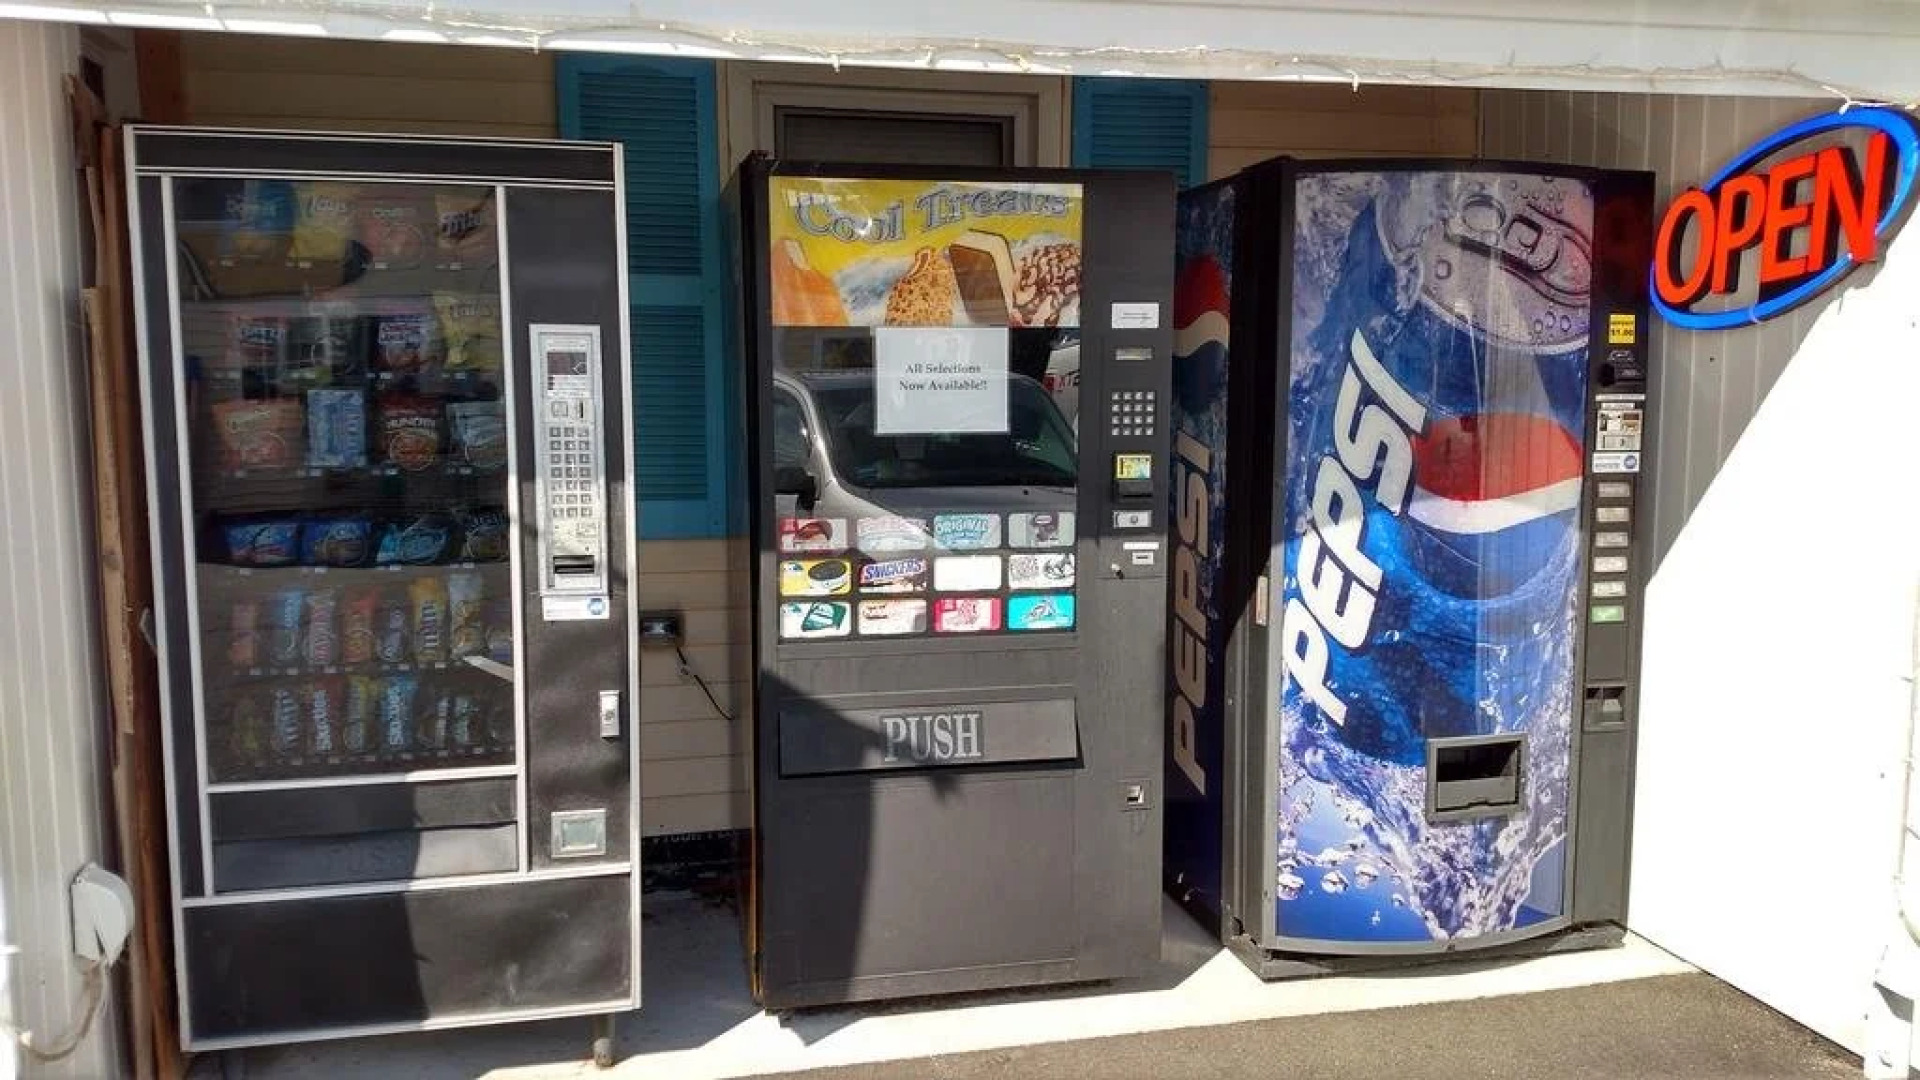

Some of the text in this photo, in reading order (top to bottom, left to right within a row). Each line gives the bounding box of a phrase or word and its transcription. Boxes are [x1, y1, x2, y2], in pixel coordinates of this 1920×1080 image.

[794, 187, 1070, 243] Cool Treats
[1655, 132, 1887, 303] OPEN
[899, 380, 925, 391] Now
[906, 362, 982, 375] All Selections
[935, 518, 989, 536] ORIGINAL
[1283, 327, 1427, 727] PEPSI
[864, 558, 922, 580] SNICKERS
[1172, 446, 1214, 796] PEPSI
[882, 713, 982, 764] PUSH
